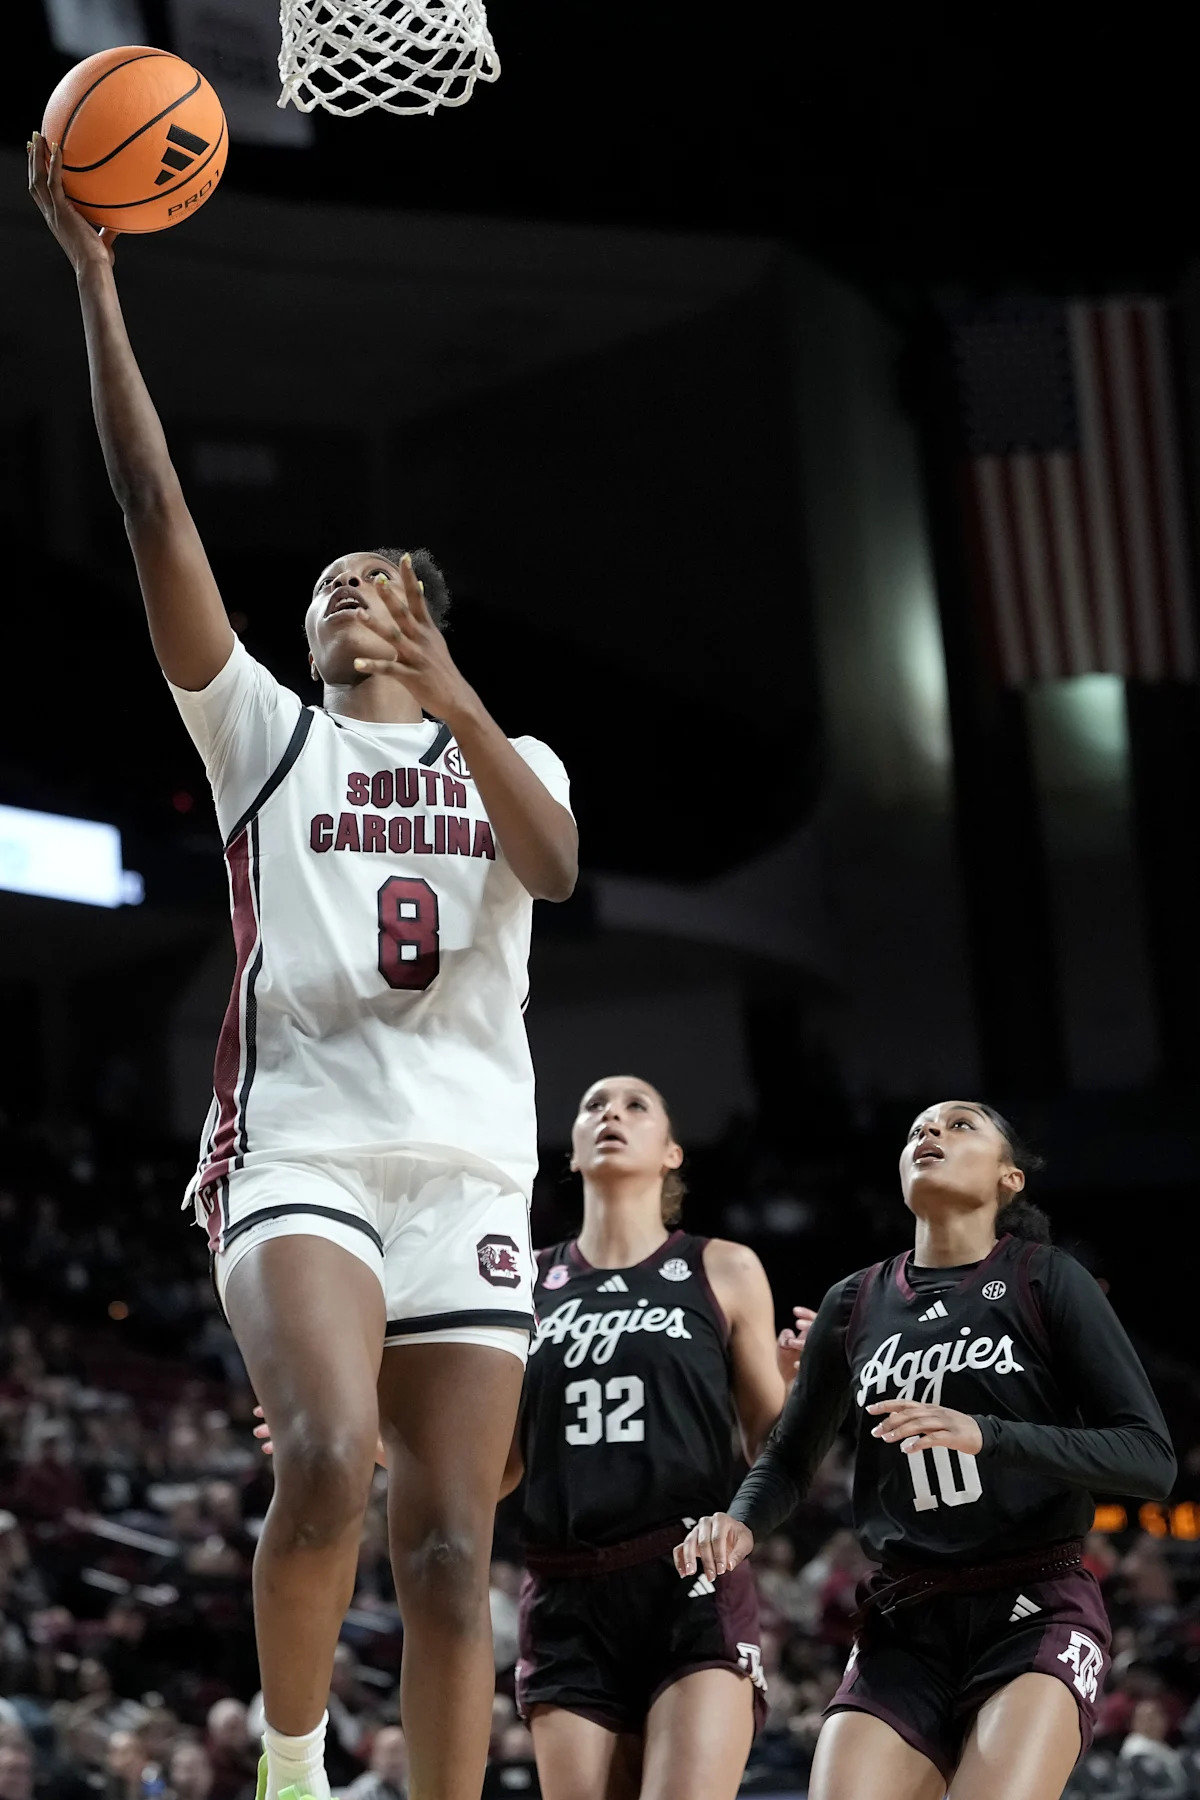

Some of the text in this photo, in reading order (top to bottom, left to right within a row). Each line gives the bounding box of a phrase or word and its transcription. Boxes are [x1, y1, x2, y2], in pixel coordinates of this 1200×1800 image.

[168, 180, 212, 217] PRO
[346, 767, 467, 809] SOUTH
[309, 812, 496, 861] CAROLINA
[377, 875, 440, 991] 8
[983, 1282, 1005, 1299] SEC
[528, 1298, 692, 1369] Aggies
[857, 1327, 1025, 1407] Aggies
[565, 1375, 645, 1446] 32
[900, 1435, 983, 1512] 10
